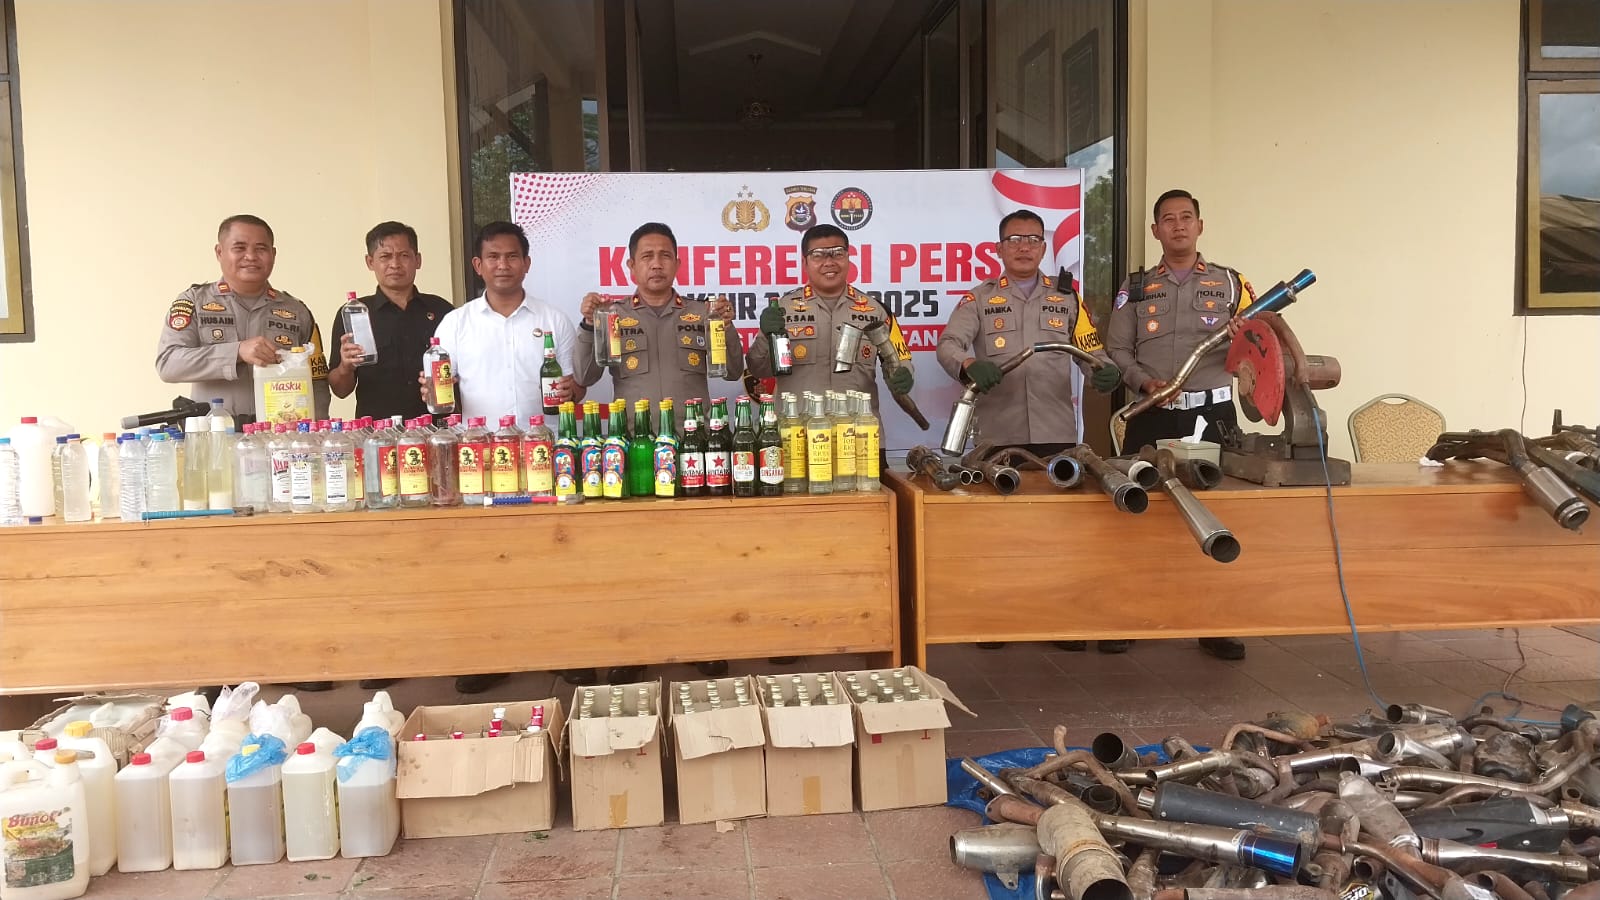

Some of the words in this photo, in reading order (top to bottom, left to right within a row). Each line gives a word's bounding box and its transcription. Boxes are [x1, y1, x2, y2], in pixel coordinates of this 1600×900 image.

[890, 242, 1002, 283] PERS
[1042, 305, 1069, 315] POLRI
[200, 316, 234, 325] HUSAIN
[268, 320, 300, 333] POLRI
[620, 327, 645, 337] ITRA
